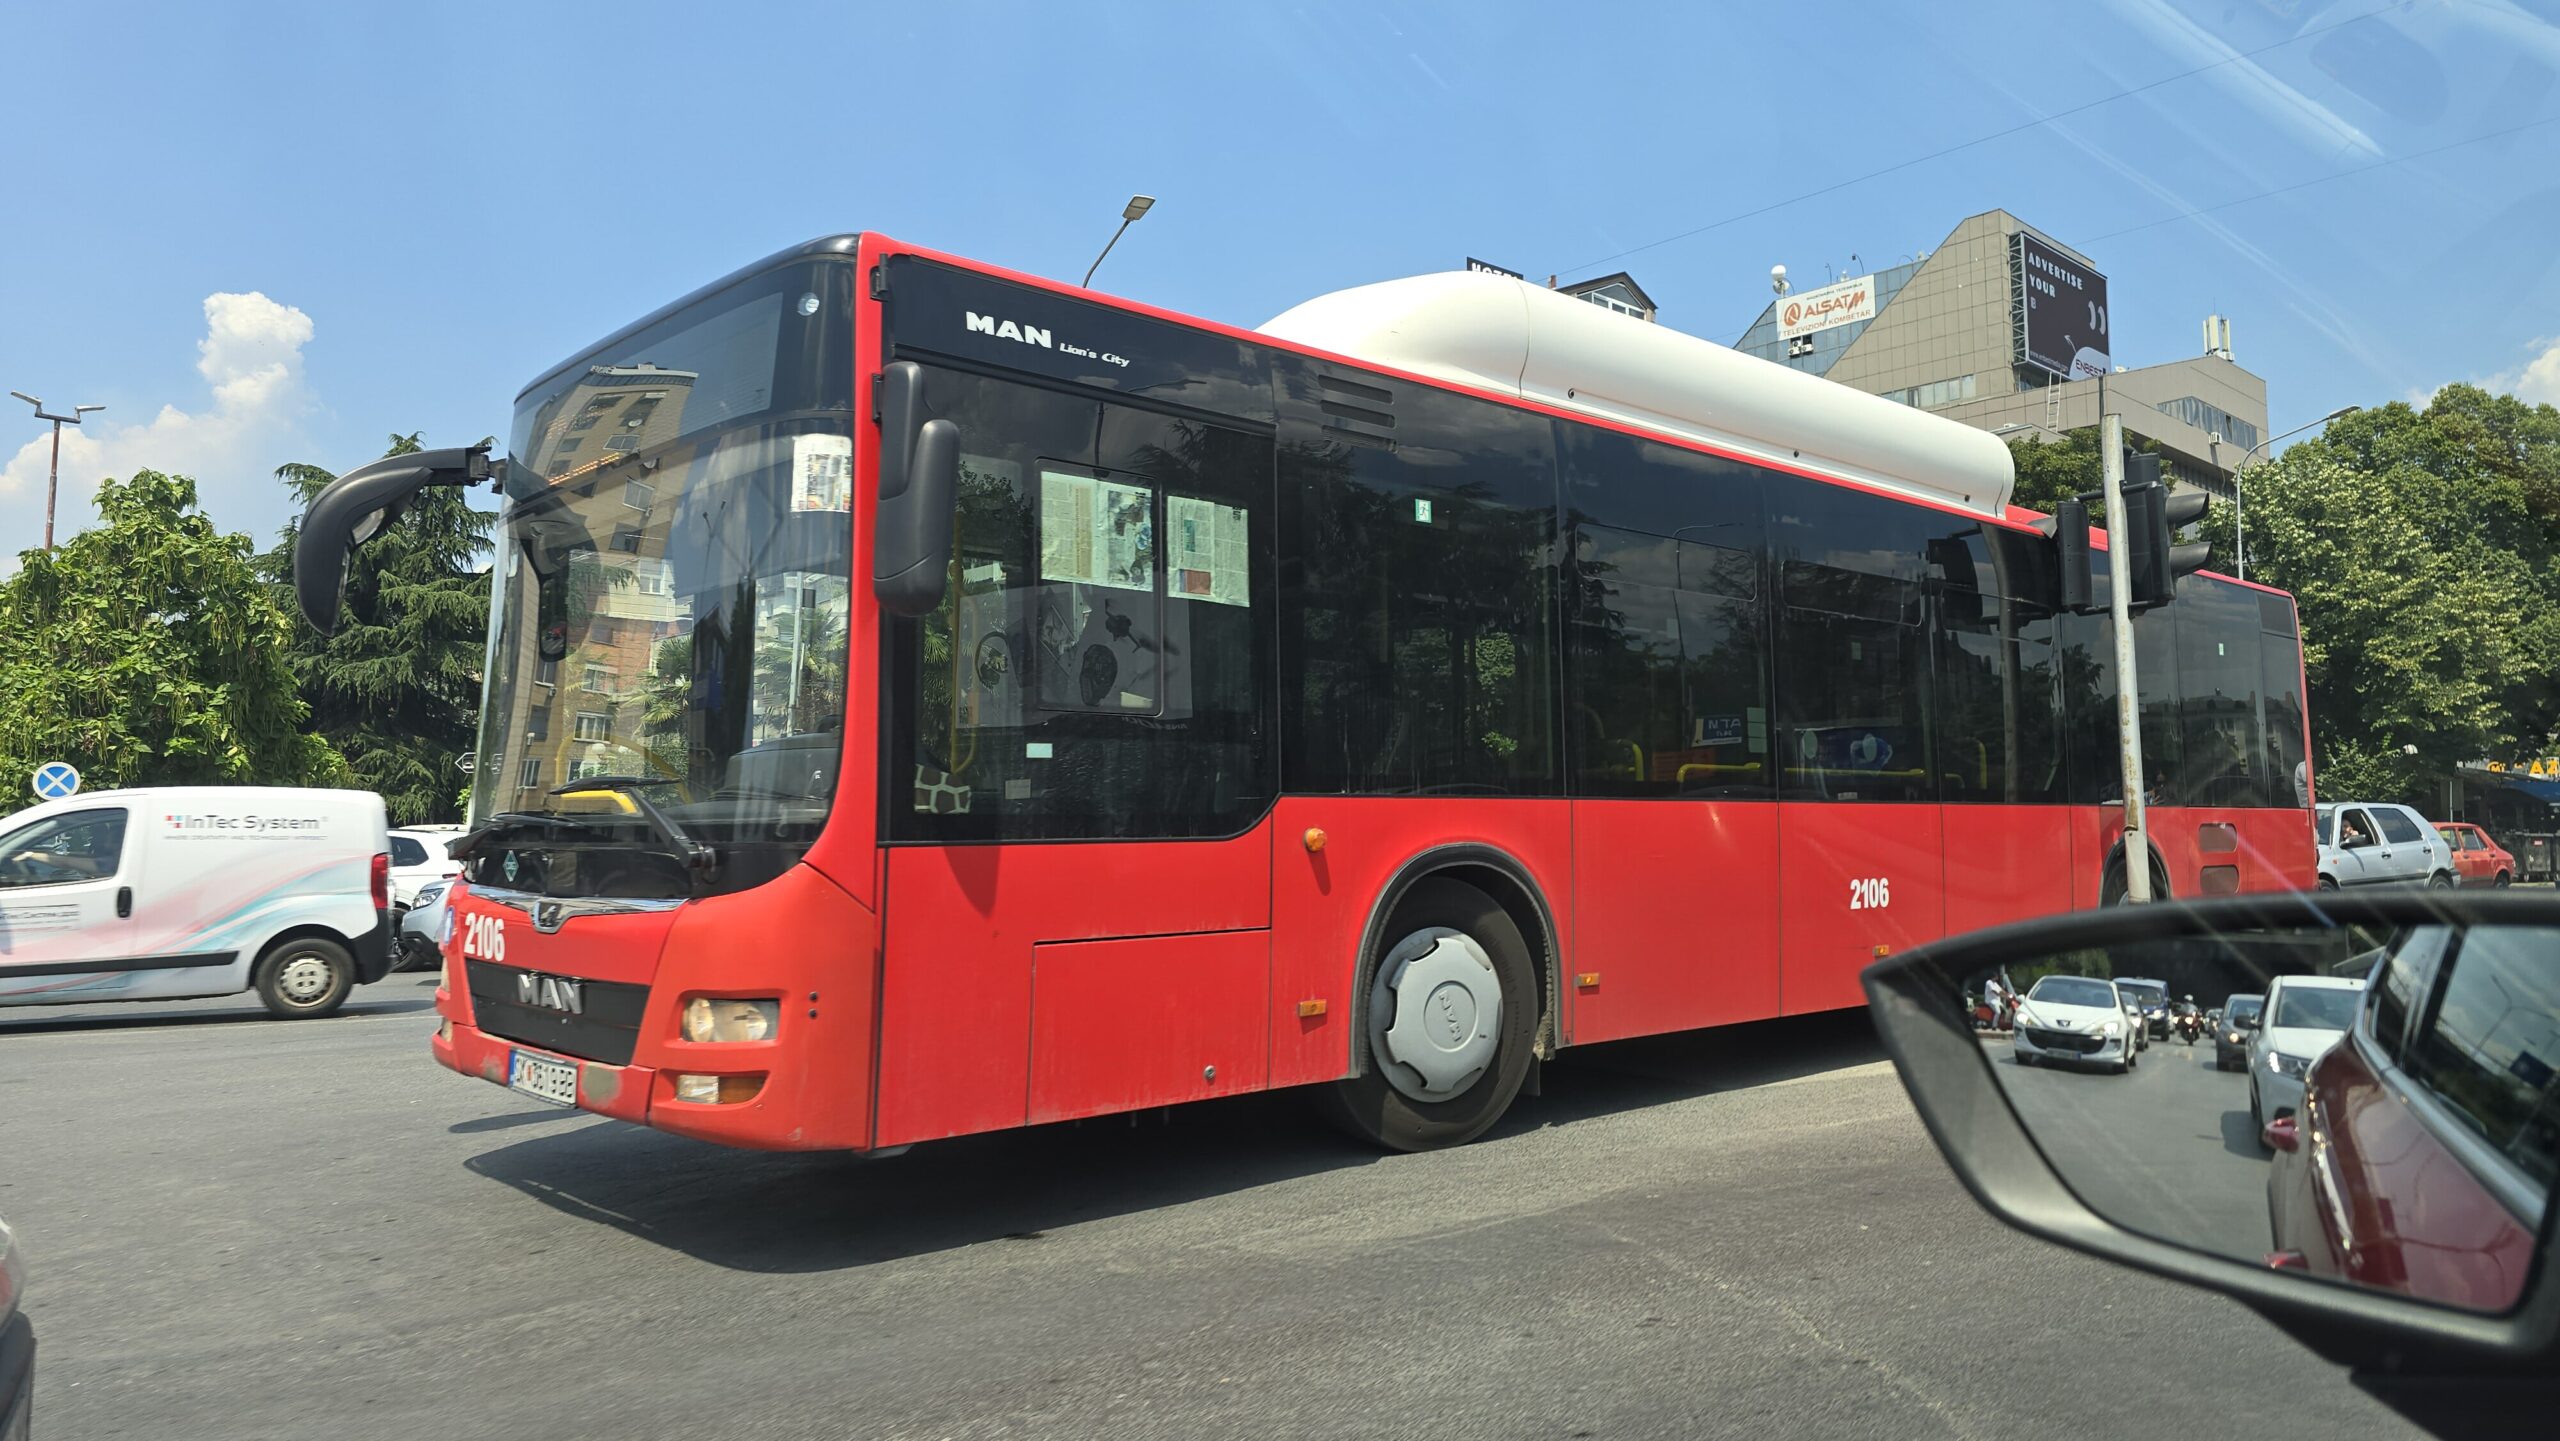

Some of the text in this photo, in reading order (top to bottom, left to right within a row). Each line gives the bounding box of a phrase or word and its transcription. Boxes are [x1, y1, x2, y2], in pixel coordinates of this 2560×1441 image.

[2028, 252, 2083, 290] ADVERTISE
[2029, 273, 2056, 298] YOUR
[965, 311, 1131, 368] MAN Lion's City
[185, 814, 320, 832] InTec System
[1850, 877, 1890, 910] 2106
[463, 912, 505, 962] 2106
[517, 971, 584, 1015] MAN
